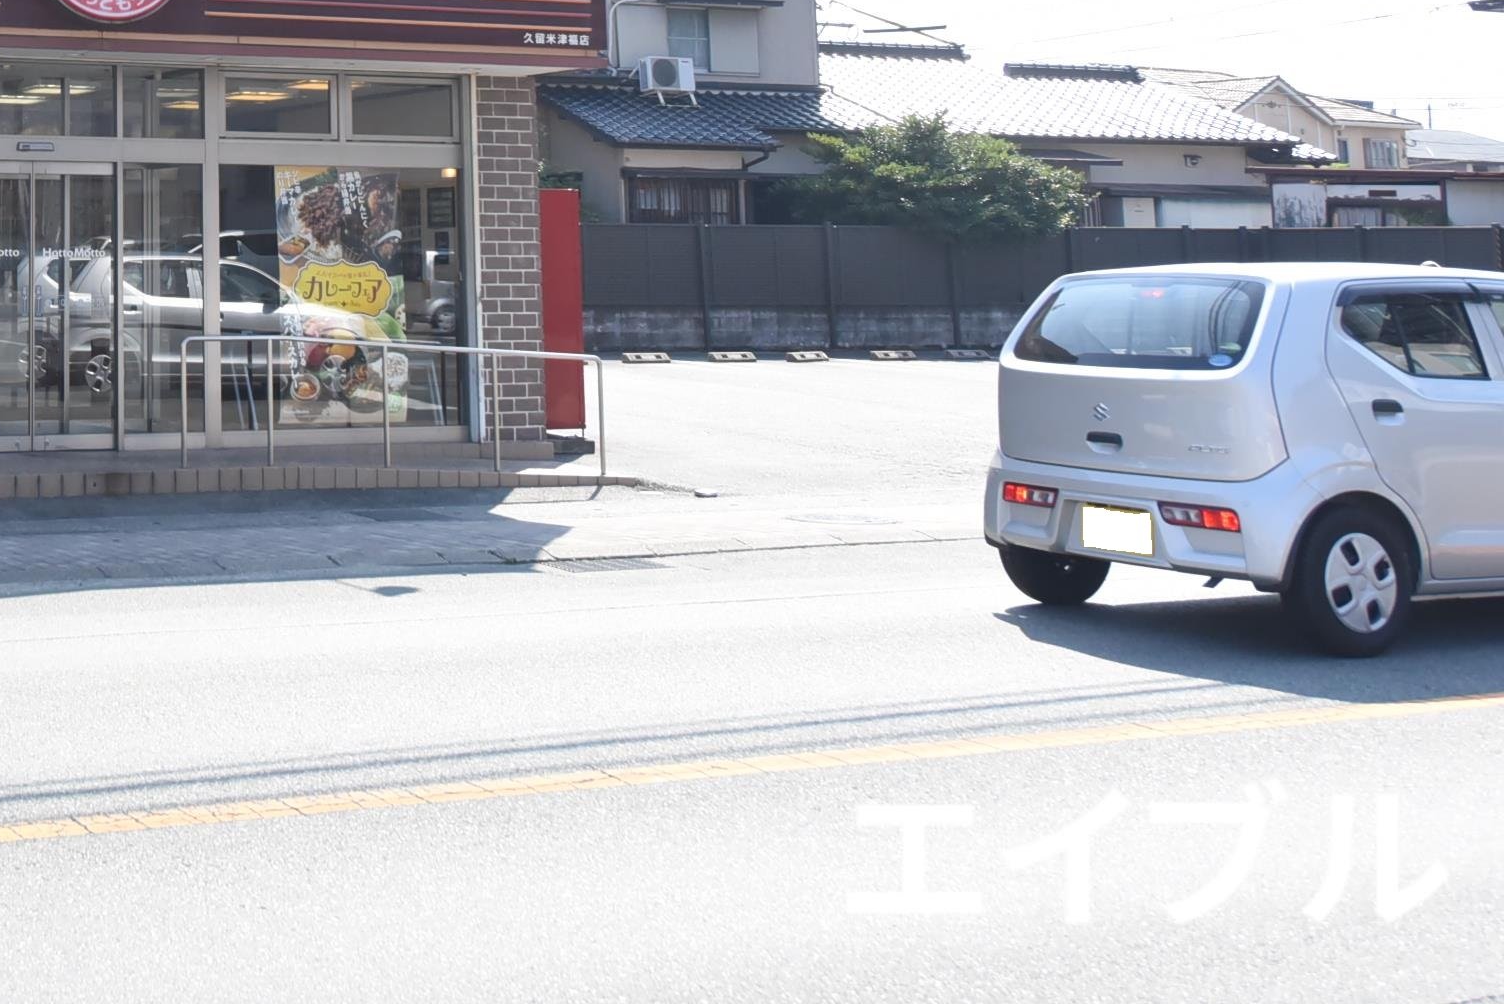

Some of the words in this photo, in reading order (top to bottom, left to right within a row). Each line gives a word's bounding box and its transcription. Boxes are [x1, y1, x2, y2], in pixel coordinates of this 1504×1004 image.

[523, 32, 590, 46] 久留米津福店
[303, 276, 383, 304] カレーフェア
